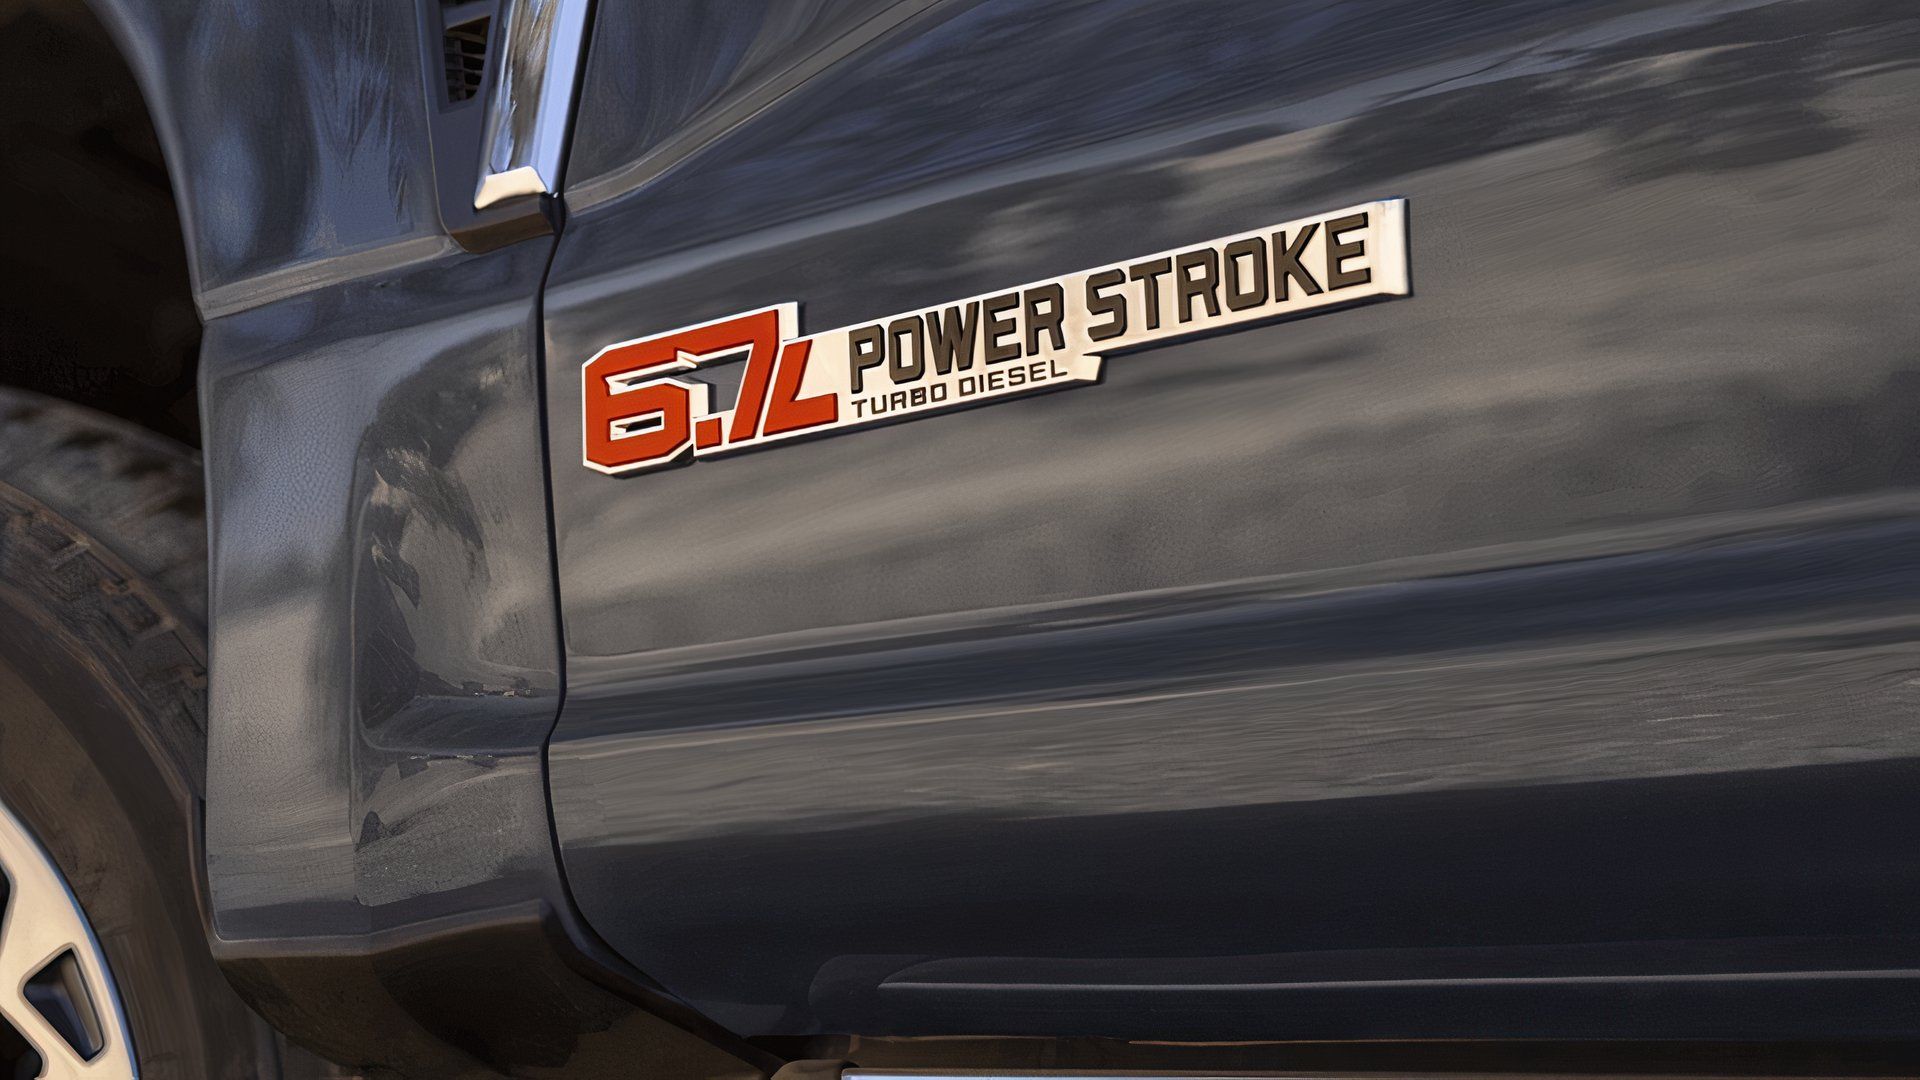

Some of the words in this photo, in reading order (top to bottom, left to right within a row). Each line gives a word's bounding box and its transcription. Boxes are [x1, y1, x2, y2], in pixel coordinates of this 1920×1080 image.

[584, 308, 838, 468] 6.7L
[849, 283, 1065, 394] POWER
[1085, 212, 1372, 342] STROKE
[852, 382, 948, 419] TURBO
[959, 359, 1068, 397] DIESEL
